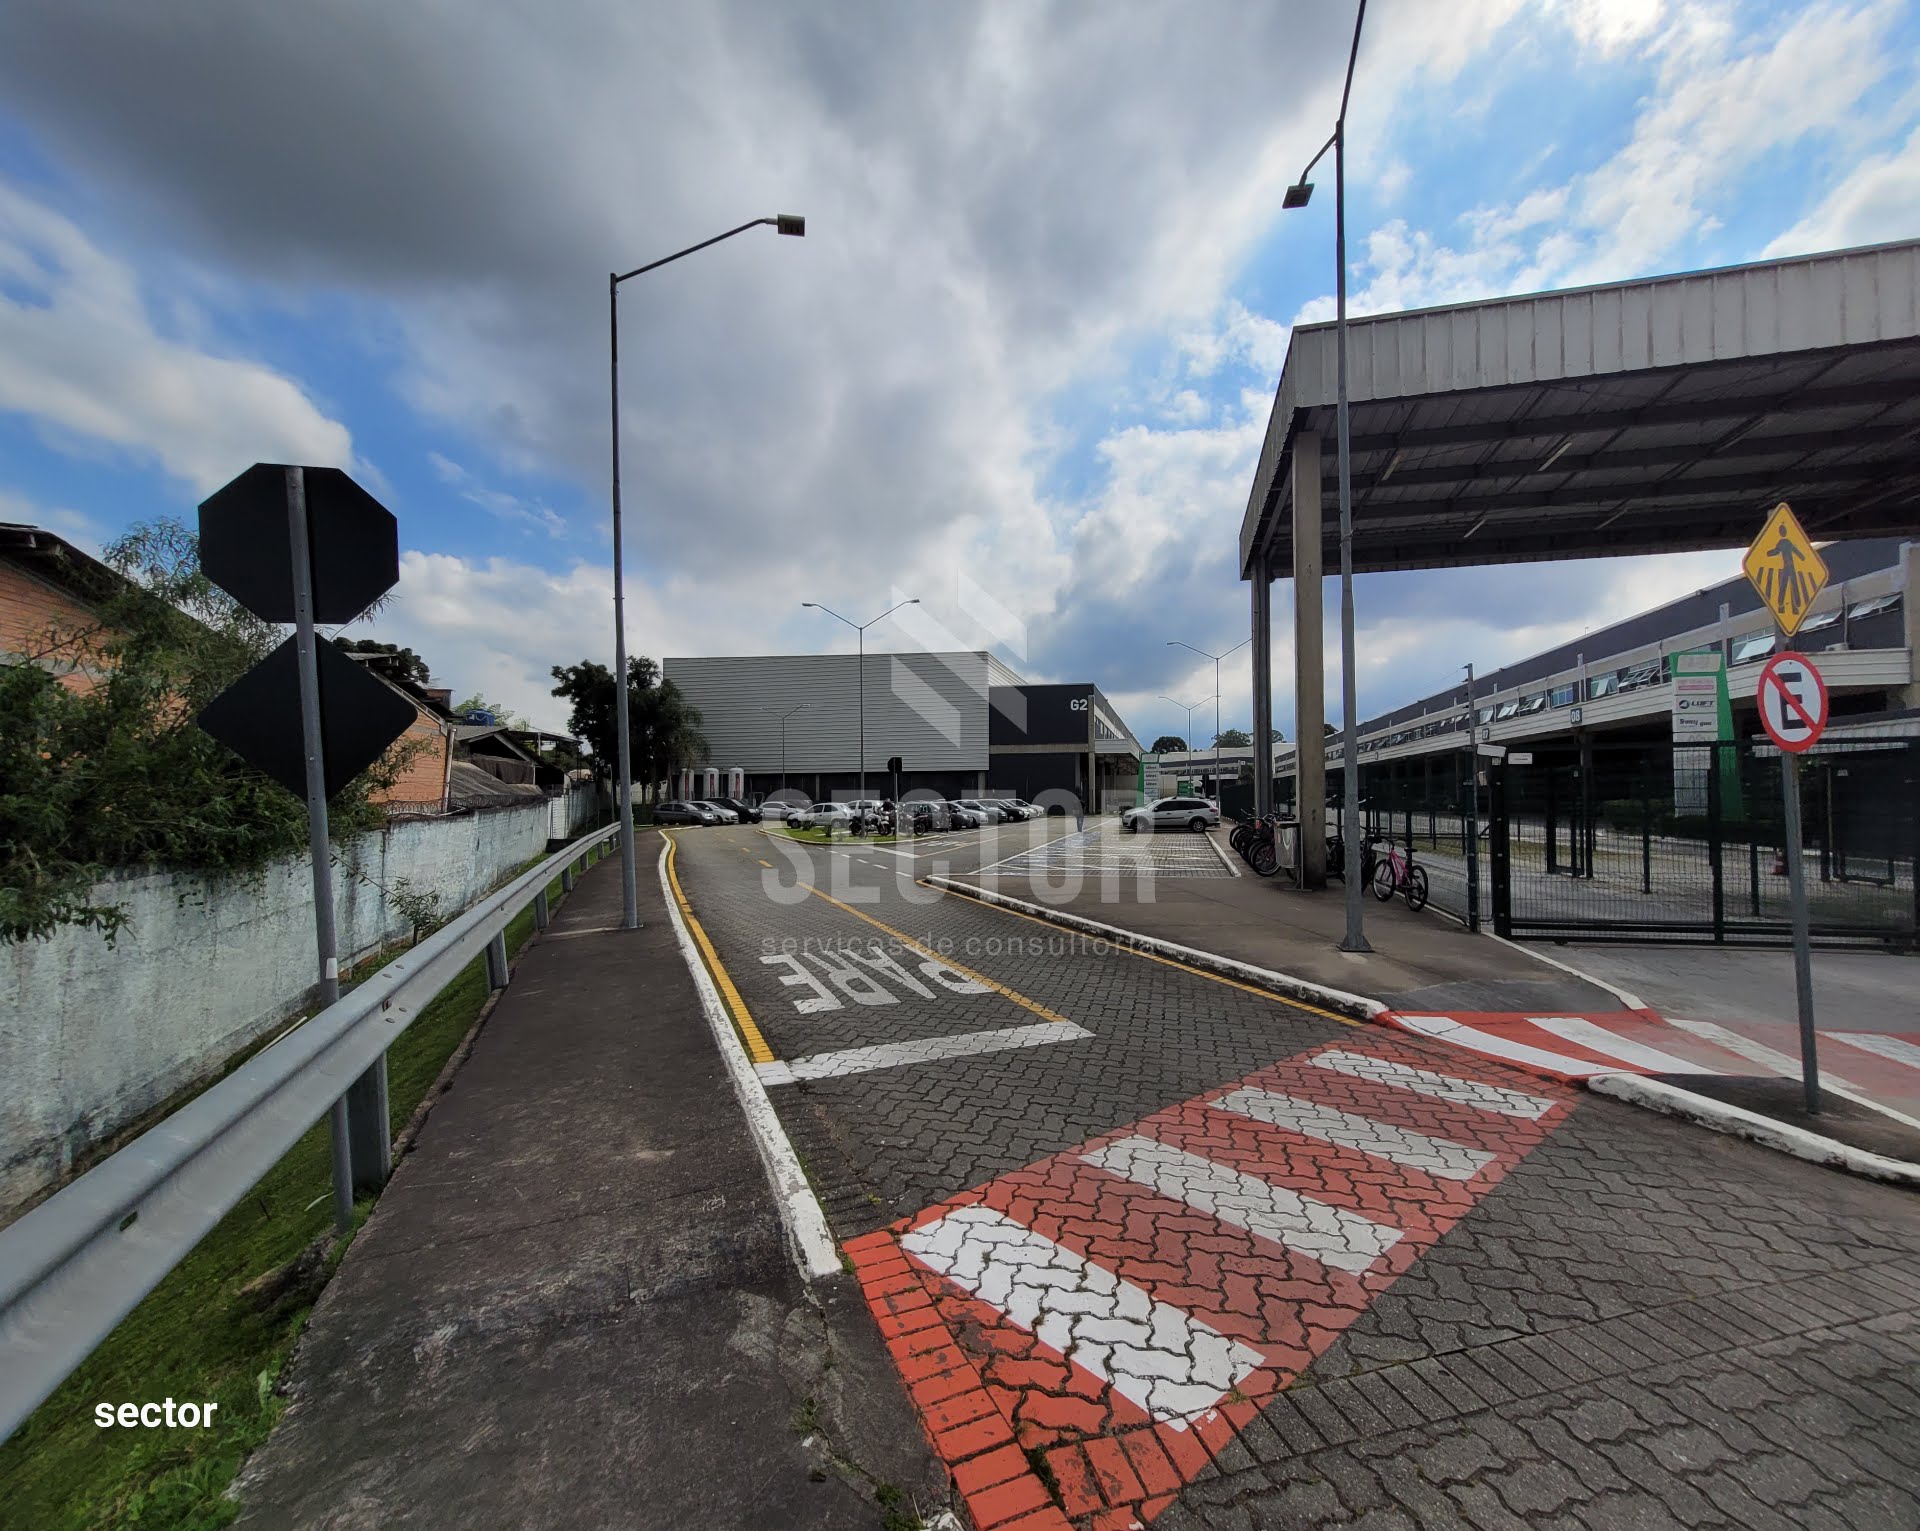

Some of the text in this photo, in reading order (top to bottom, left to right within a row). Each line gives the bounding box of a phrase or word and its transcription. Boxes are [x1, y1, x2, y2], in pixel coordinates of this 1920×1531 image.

[1070, 698, 1088, 711] G2
[1571, 710, 1580, 723] 08
[1777, 672, 1809, 730] E
[758, 943, 998, 1014] PARE
